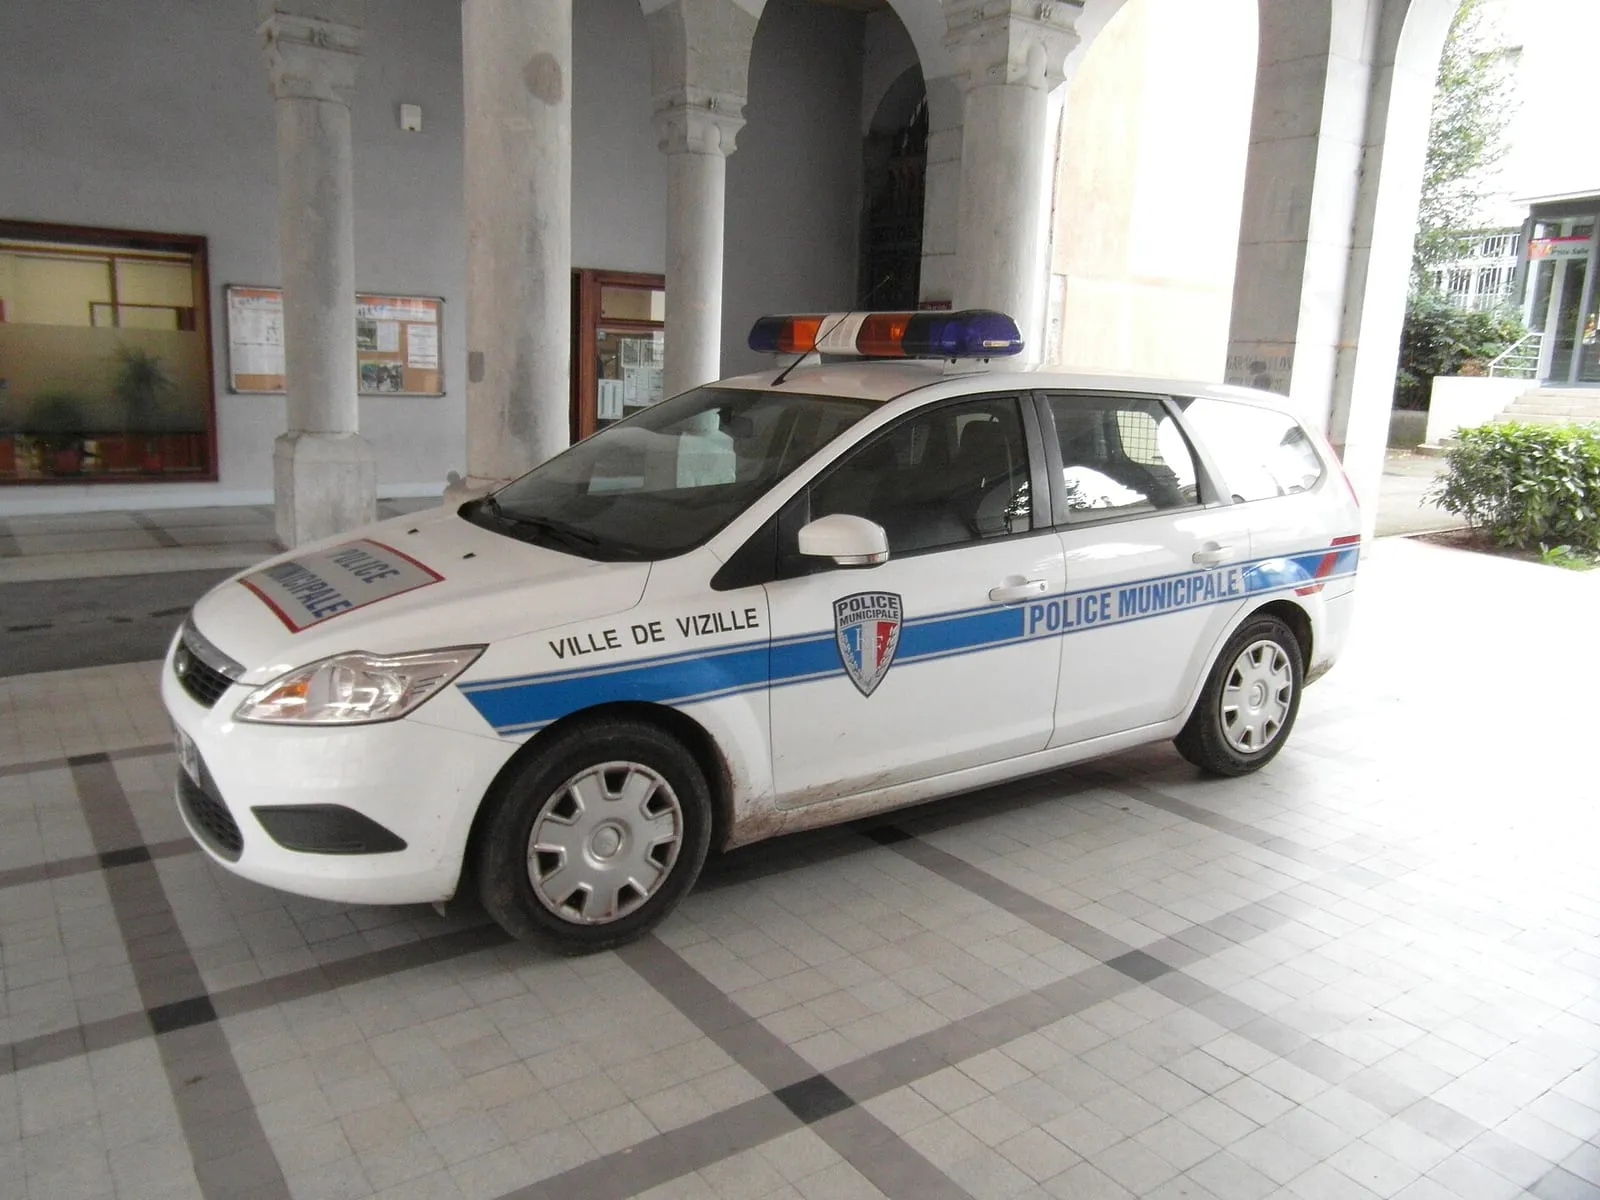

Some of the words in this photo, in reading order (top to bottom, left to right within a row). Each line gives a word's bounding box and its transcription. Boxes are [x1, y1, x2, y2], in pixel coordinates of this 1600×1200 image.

[328, 549, 400, 583] POLICE
[263, 561, 352, 617] ICIPALE
[837, 595, 898, 616] POLICE
[1029, 592, 1112, 634] POLICE
[1118, 569, 1238, 618] MUNICIPALE
[549, 629, 622, 659] VILLE
[631, 621, 665, 645] DE
[676, 608, 760, 638] VIZILLE
[839, 609, 899, 627] MUNICIPALE
